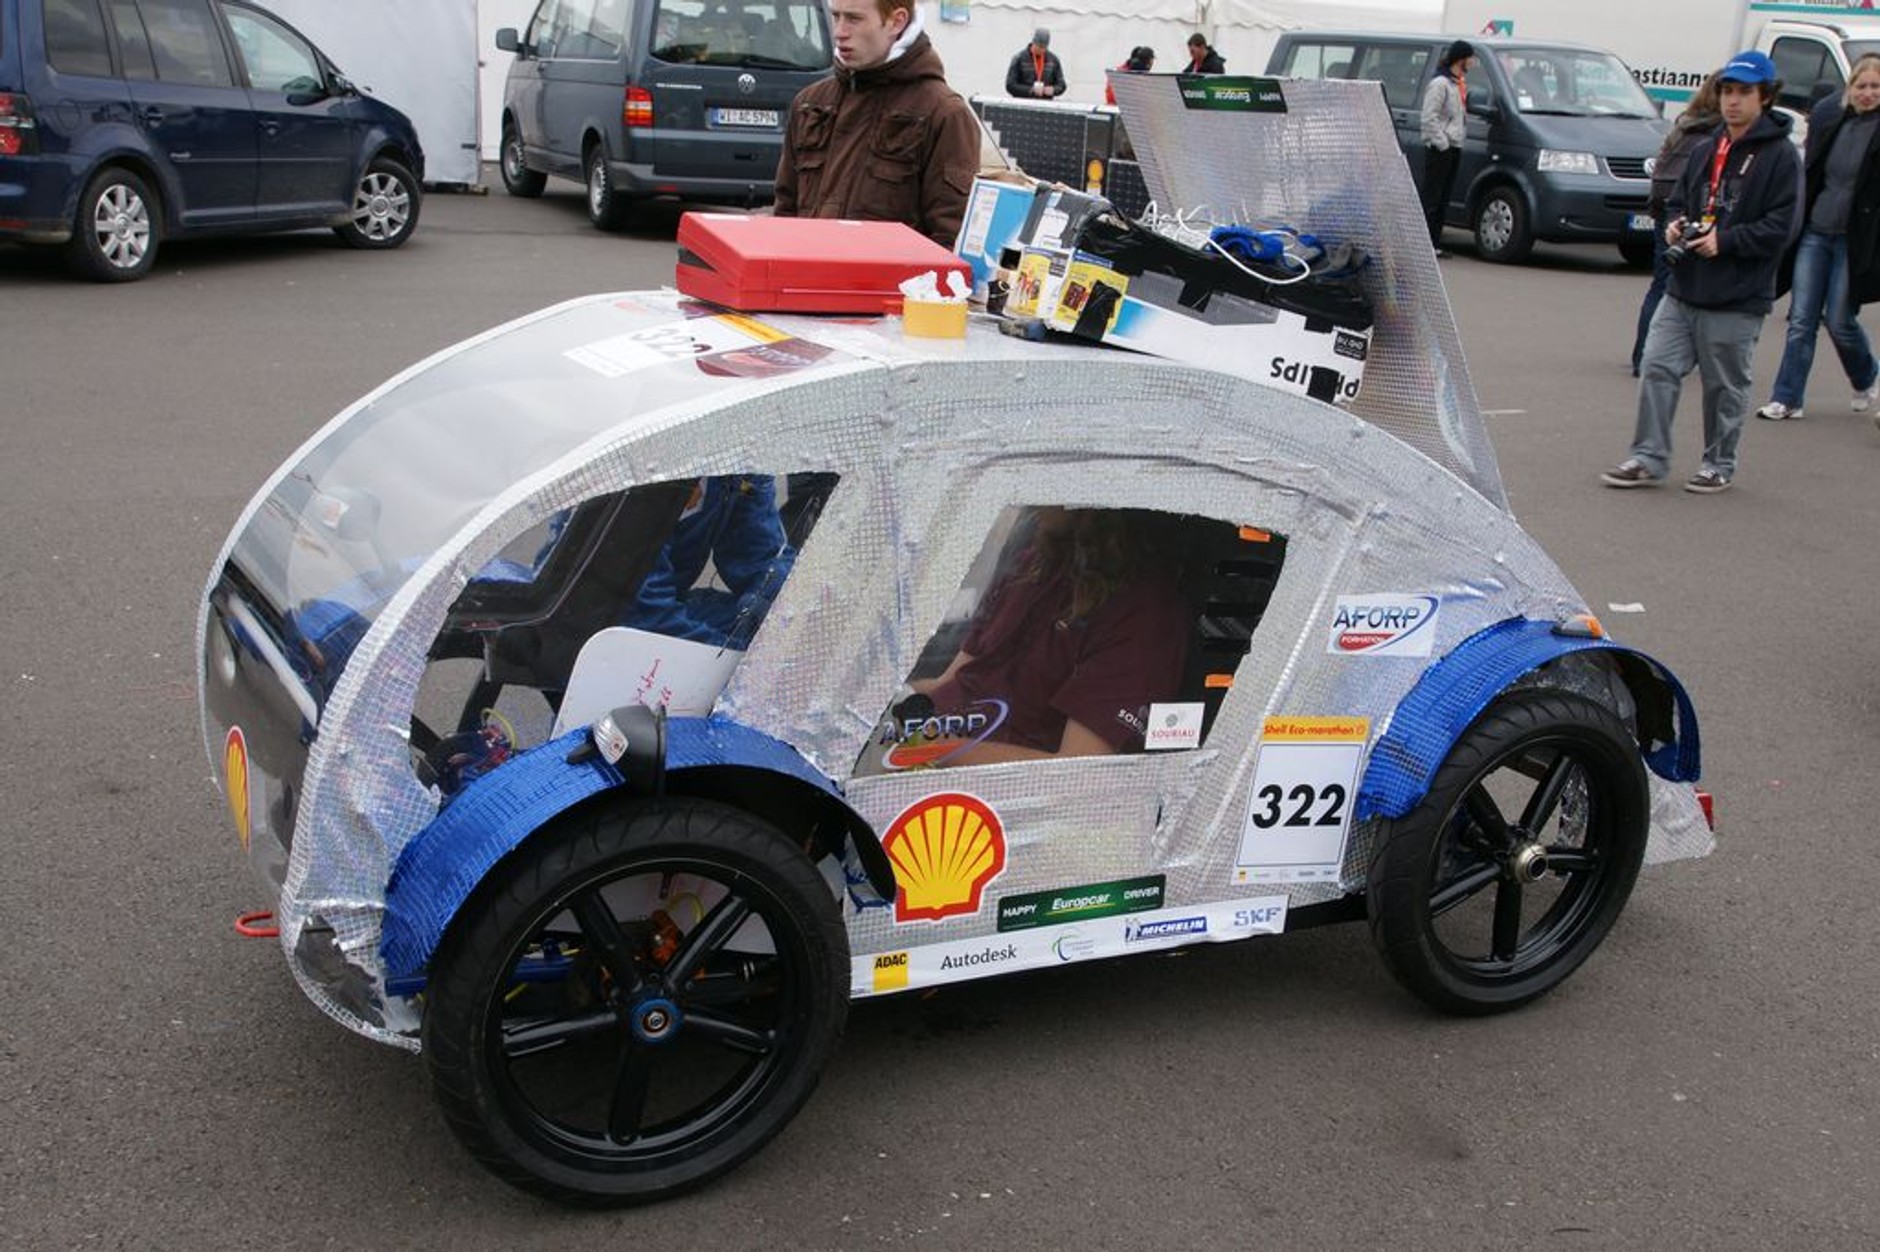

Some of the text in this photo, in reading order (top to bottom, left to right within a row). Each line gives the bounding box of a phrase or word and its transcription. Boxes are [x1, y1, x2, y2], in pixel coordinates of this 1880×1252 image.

[1270, 356, 1360, 398] PHIPS
[1333, 605, 1420, 629] AFORP
[880, 714, 987, 744] AFORP
[1264, 724, 1354, 736] Shell Eco-marathon
[1252, 784, 1346, 829] 322
[1003, 886, 1160, 918] HAPPY Europcar DRIVER
[1141, 919, 1205, 936] MICHELIN
[1234, 907, 1282, 927] SKF
[874, 953, 908, 969] ADAC
[940, 944, 1018, 971] Autodesk
